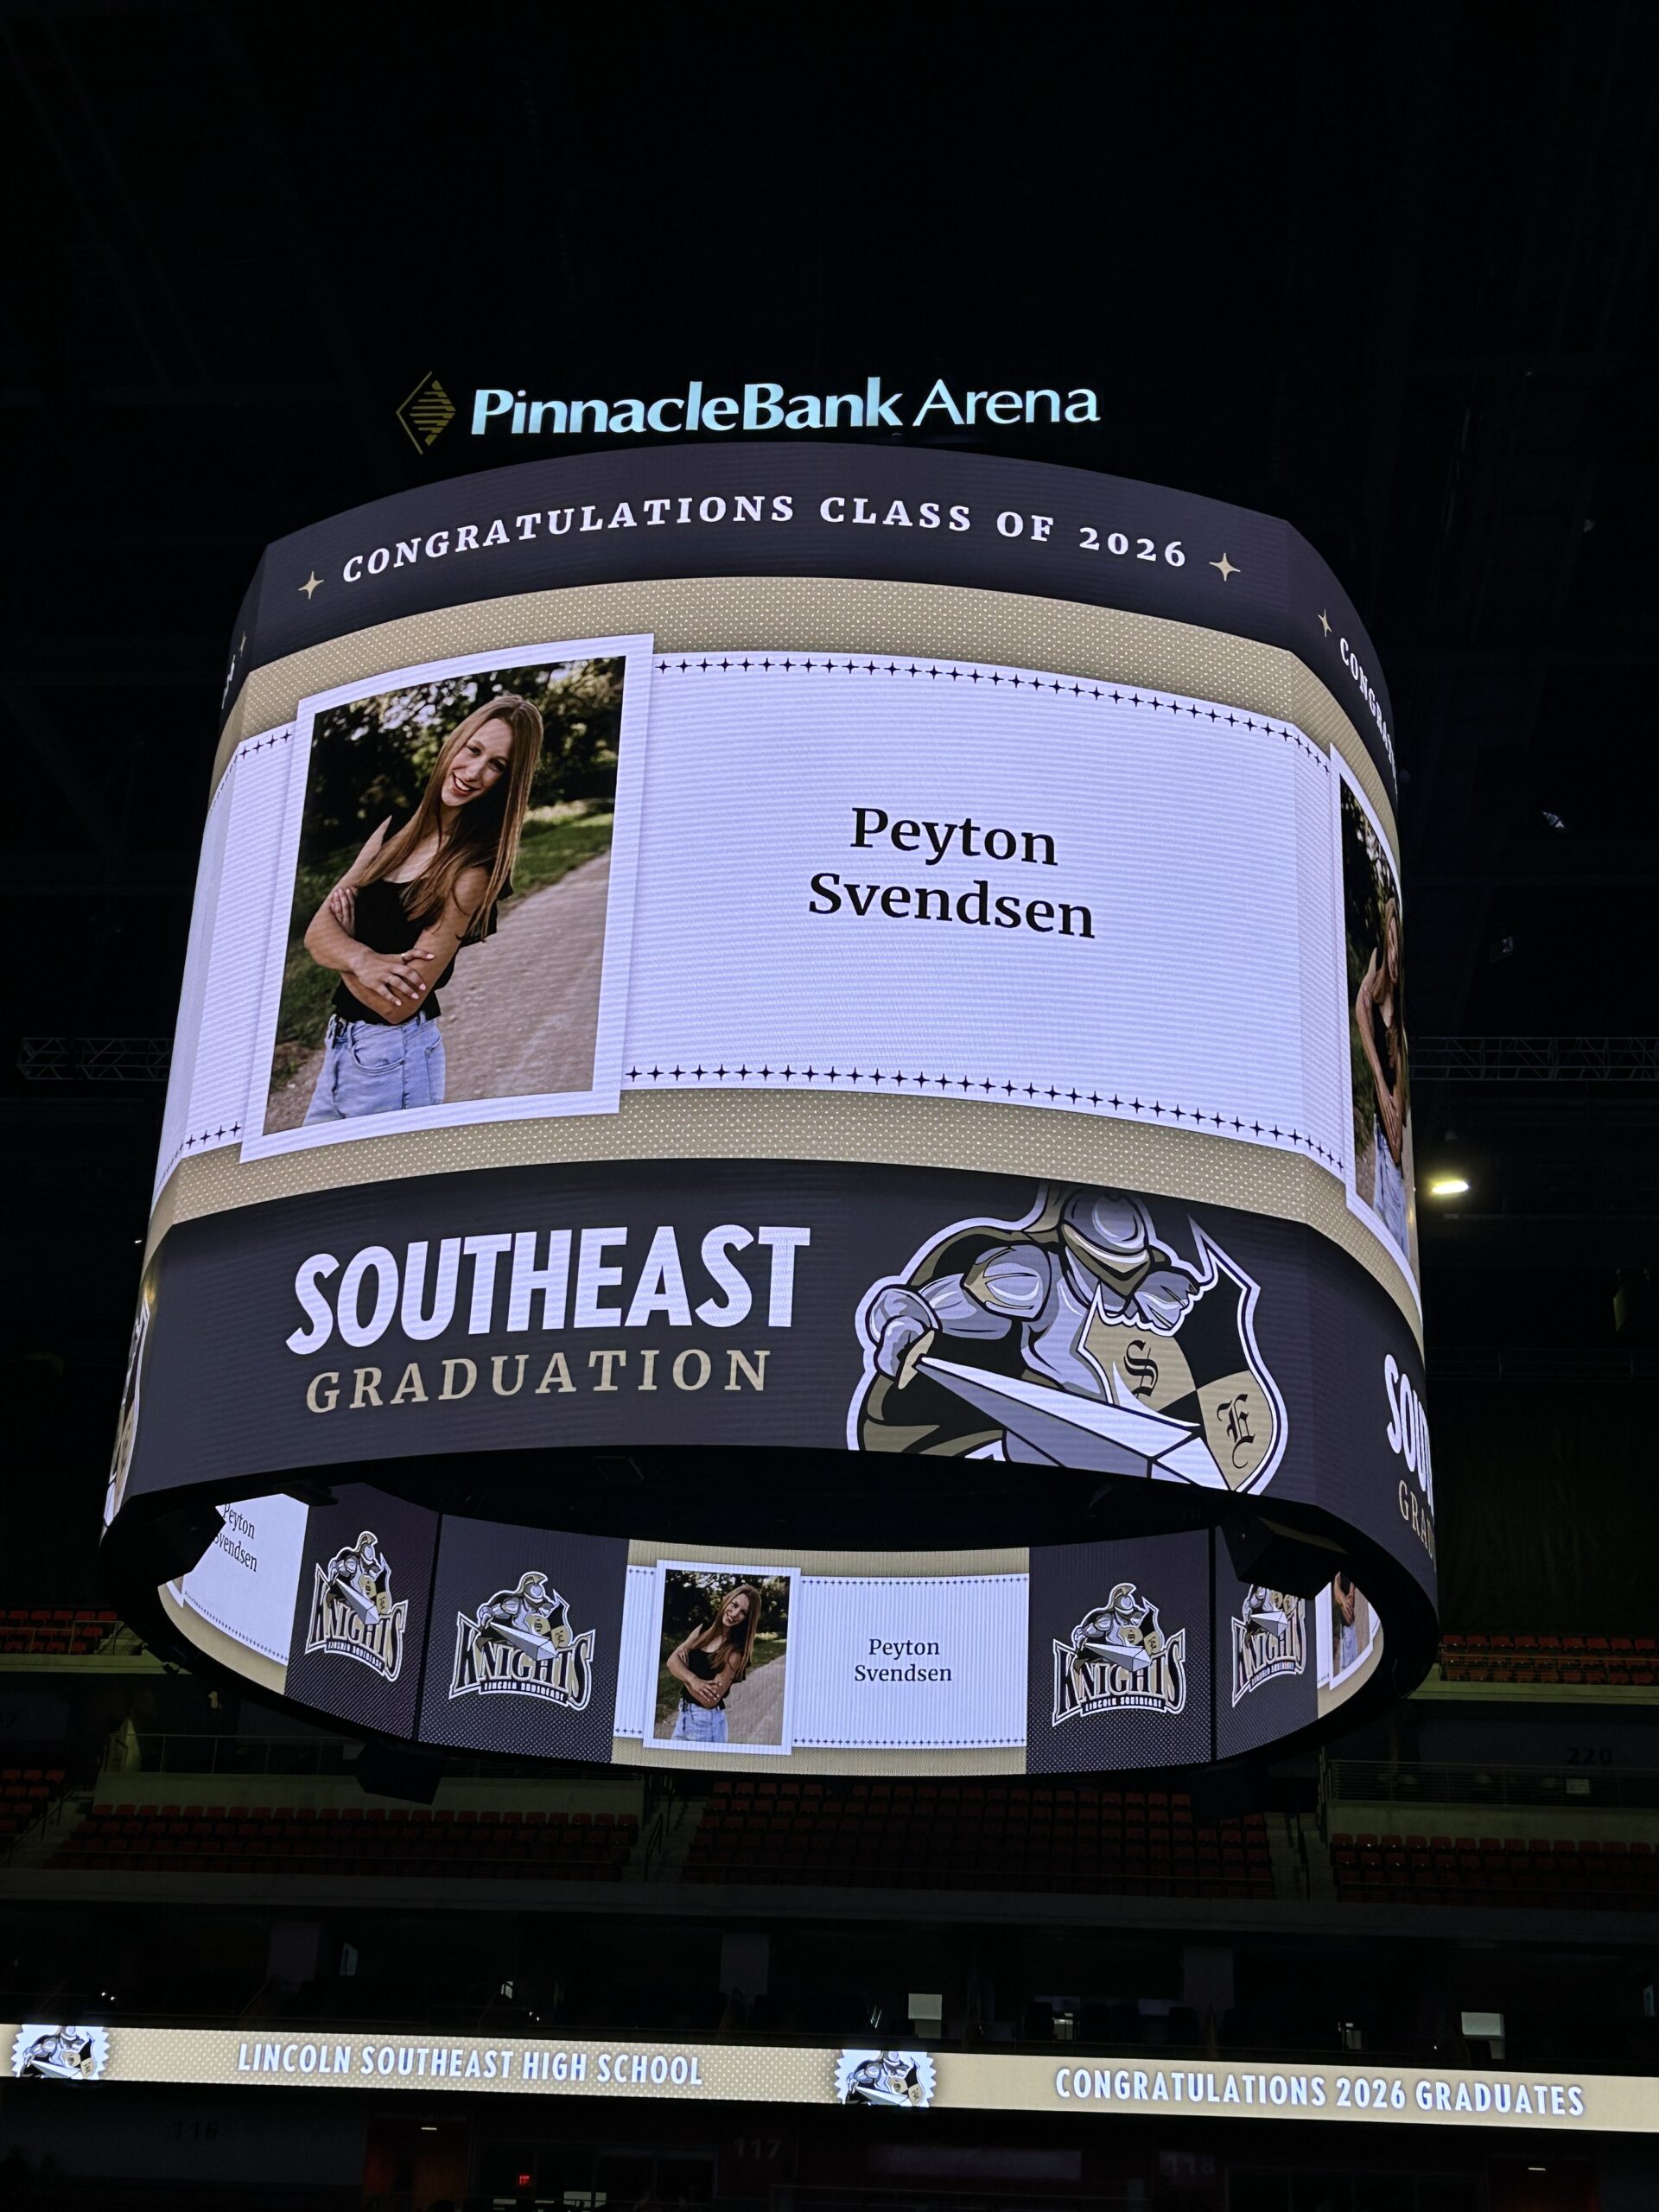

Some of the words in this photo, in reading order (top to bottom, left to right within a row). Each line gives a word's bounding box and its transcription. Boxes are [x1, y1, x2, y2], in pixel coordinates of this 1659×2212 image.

[471, 377, 904, 435] PinnacleBank
[912, 378, 1101, 427] Arena
[343, 495, 793, 582] CONGRATULATIONS
[820, 497, 970, 531] CLASS
[996, 511, 1054, 542] OF
[1079, 527, 1185, 567] 2026
[850, 807, 1058, 866] Peyton
[809, 873, 1095, 939] Svendsen
[285, 1224, 810, 1355] SOUTHEAST
[306, 1349, 771, 1414] GRADUATION
[223, 1503, 255, 1540] Peyton
[449, 1611, 595, 1710] KNIGHTS
[855, 1663, 953, 1681] Svendsen
[868, 1638, 940, 1660] Peyton
[1052, 1629, 1185, 1726] KNIGHTS
[1567, 1746, 1612, 1764] 220
[238, 2043, 350, 2075] LINCOLN
[360, 2046, 514, 2079] SOUTHEAST
[522, 2050, 588, 2082] HIGH
[596, 2053, 704, 2086] SCHOOL
[1056, 2068, 1326, 2107] CONGRATULATIONS
[1336, 2077, 1406, 2109] 2026
[1415, 2080, 1584, 2116] GRADUATES
